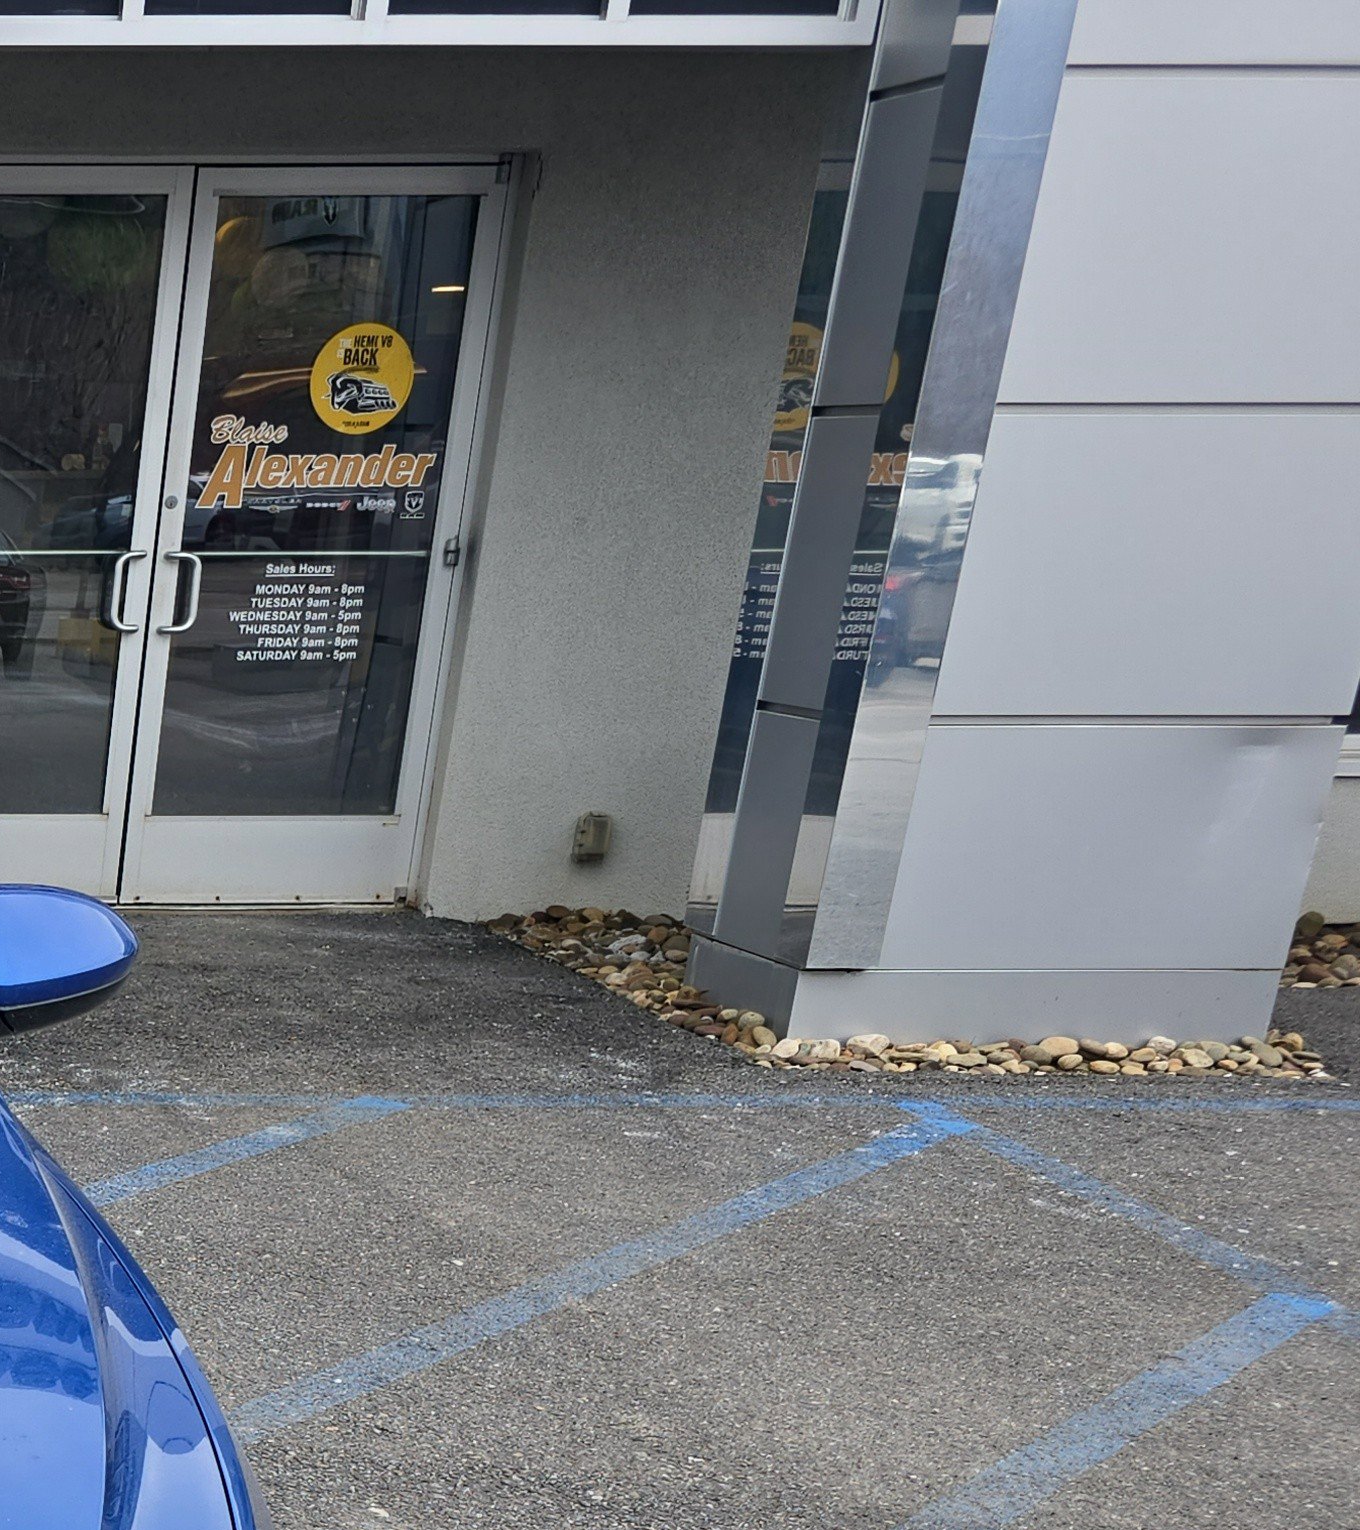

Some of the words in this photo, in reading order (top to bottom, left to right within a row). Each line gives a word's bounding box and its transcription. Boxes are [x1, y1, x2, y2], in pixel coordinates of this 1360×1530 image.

[354, 335, 379, 348] HEMI
[381, 335, 393, 348] V8
[343, 348, 379, 365] BACK
[211, 414, 289, 444] Blaise
[195, 443, 437, 509] Alexander
[265, 563, 296, 574] Sales
[299, 563, 336, 574] Hours:
[255, 584, 306, 595] MONDAY
[308, 584, 331, 594] 9am
[341, 583, 365, 595] 8pm
[250, 597, 304, 608] TUESDAY
[306, 597, 329, 608] 9am
[339, 597, 363, 609] 8pm
[229, 611, 303, 621] WEDNESDAY
[305, 611, 328, 620] 9am
[338, 610, 361, 622] 5pm
[239, 624, 301, 634] THURSDAY
[303, 624, 326, 634] 9am
[336, 623, 360, 635] 8pm
[257, 637, 299, 648] FRIDAY
[301, 637, 324, 647] 9am
[334, 637, 358, 649] 8pm
[236, 650, 298, 661] SATURDAY
[300, 650, 323, 660] 9am
[333, 650, 357, 662] 5pm
